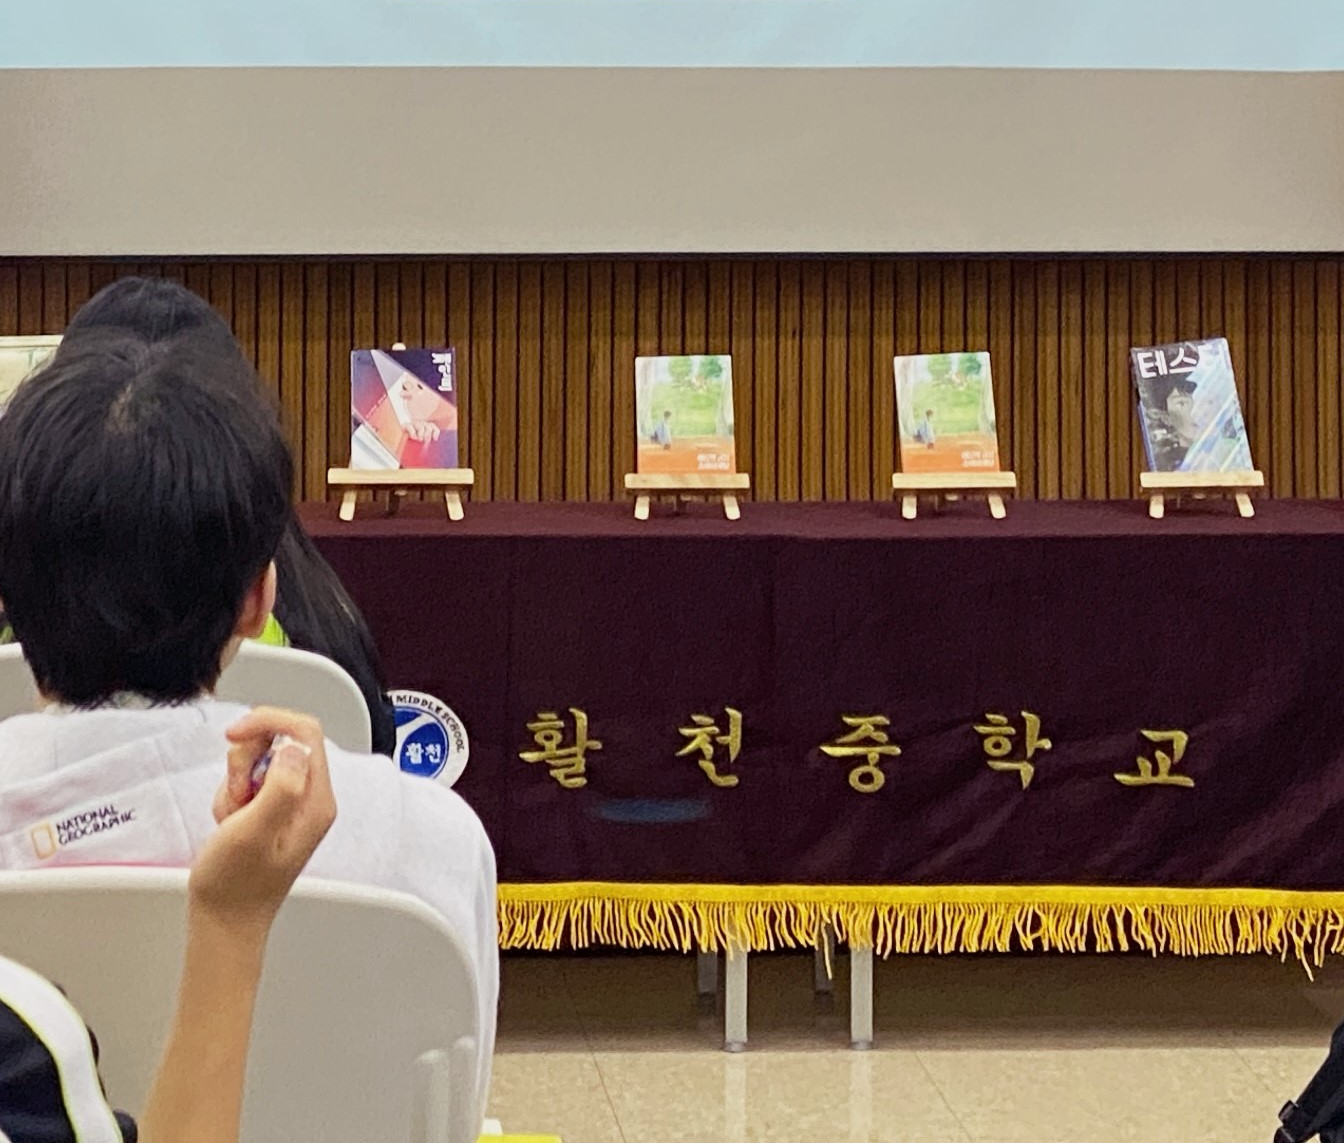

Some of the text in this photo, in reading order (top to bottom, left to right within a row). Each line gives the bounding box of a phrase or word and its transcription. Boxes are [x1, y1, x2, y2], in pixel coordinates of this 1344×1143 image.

[395, 695, 465, 754] MIDDLE SCHOOL
[56, 803, 119, 835] NATIONAL
[58, 807, 137, 846] GEOGRAPHIC
